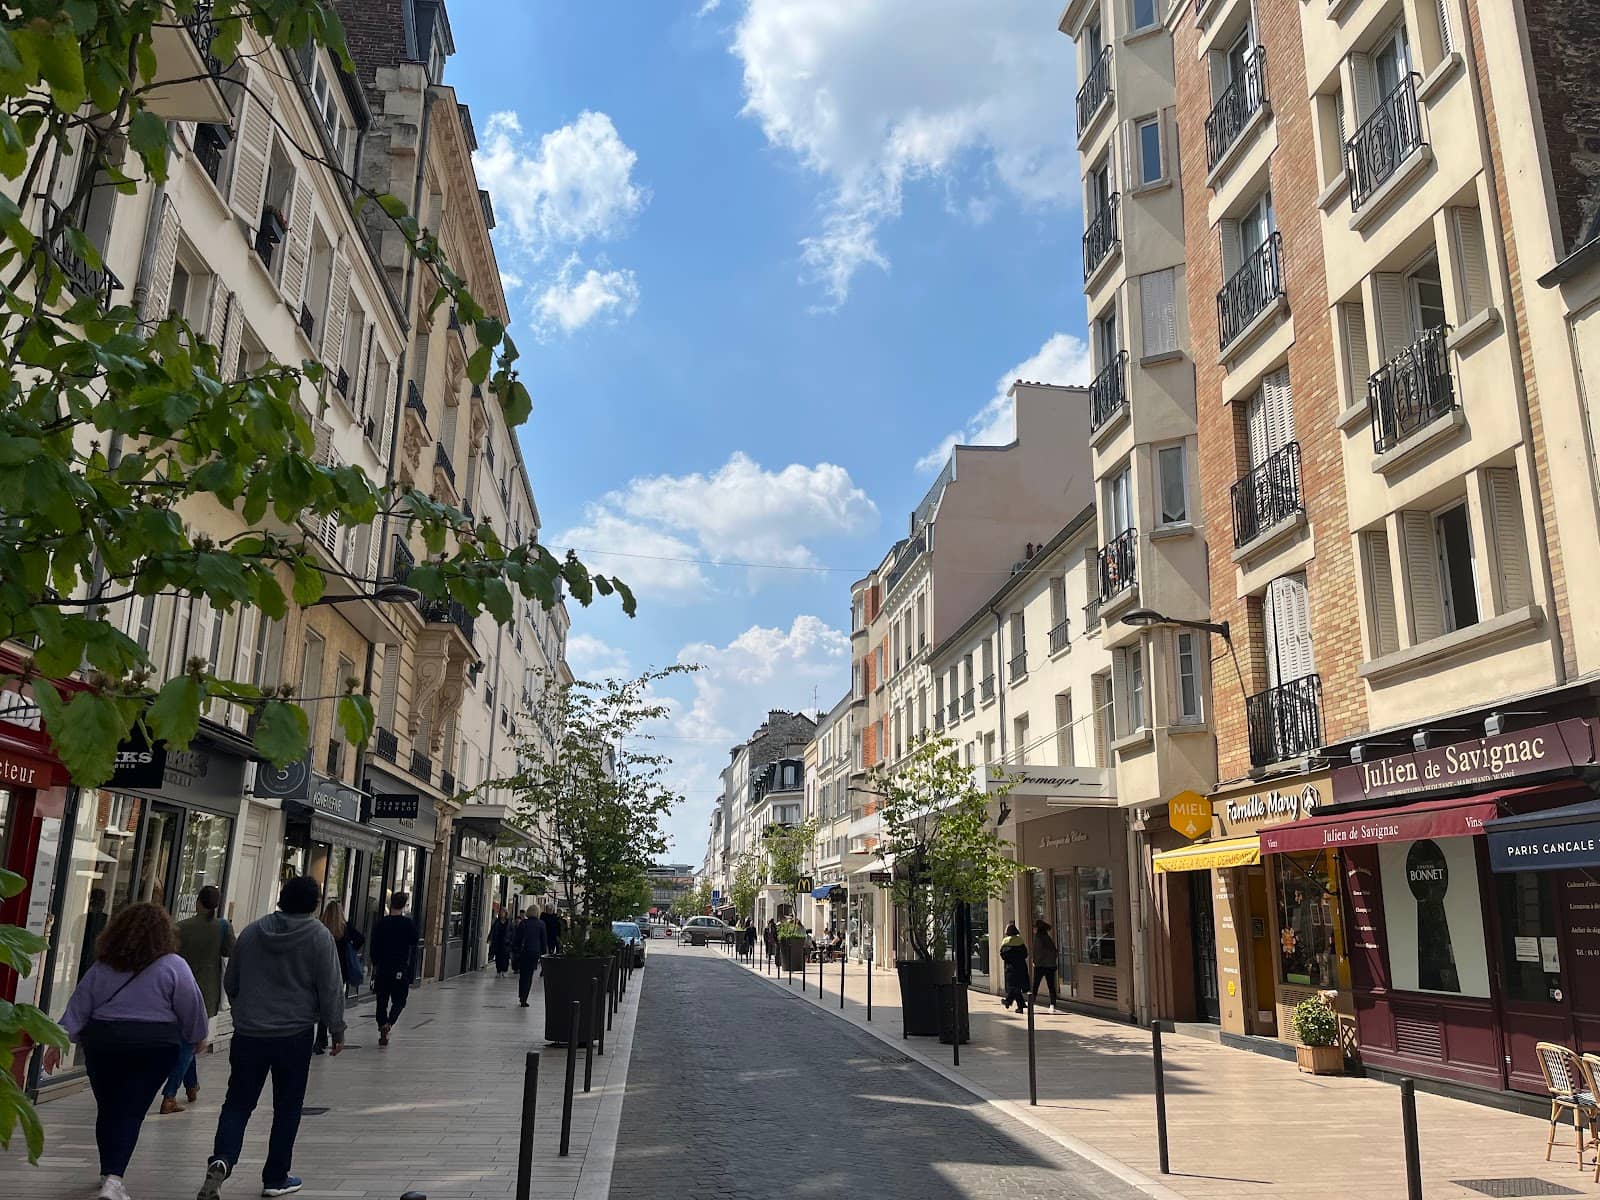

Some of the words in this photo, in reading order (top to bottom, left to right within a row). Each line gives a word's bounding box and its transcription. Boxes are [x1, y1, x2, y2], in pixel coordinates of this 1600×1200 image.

[1362, 759, 1418, 793] Julien
[1424, 760, 1441, 779] de
[1445, 737, 1545, 772] Savignac
[1173, 803, 1206, 816] MIEL
[1226, 795, 1265, 821] Famille
[1267, 792, 1298, 820] Mary
[1464, 817, 1483, 828] Vins
[1323, 829, 1347, 845] Julien
[1349, 828, 1358, 839] de
[1361, 824, 1399, 840] Savignac
[1507, 845, 1539, 856] PARIS
[1542, 840, 1595, 853] CANCALE
[1410, 869, 1443, 880] BONNET
